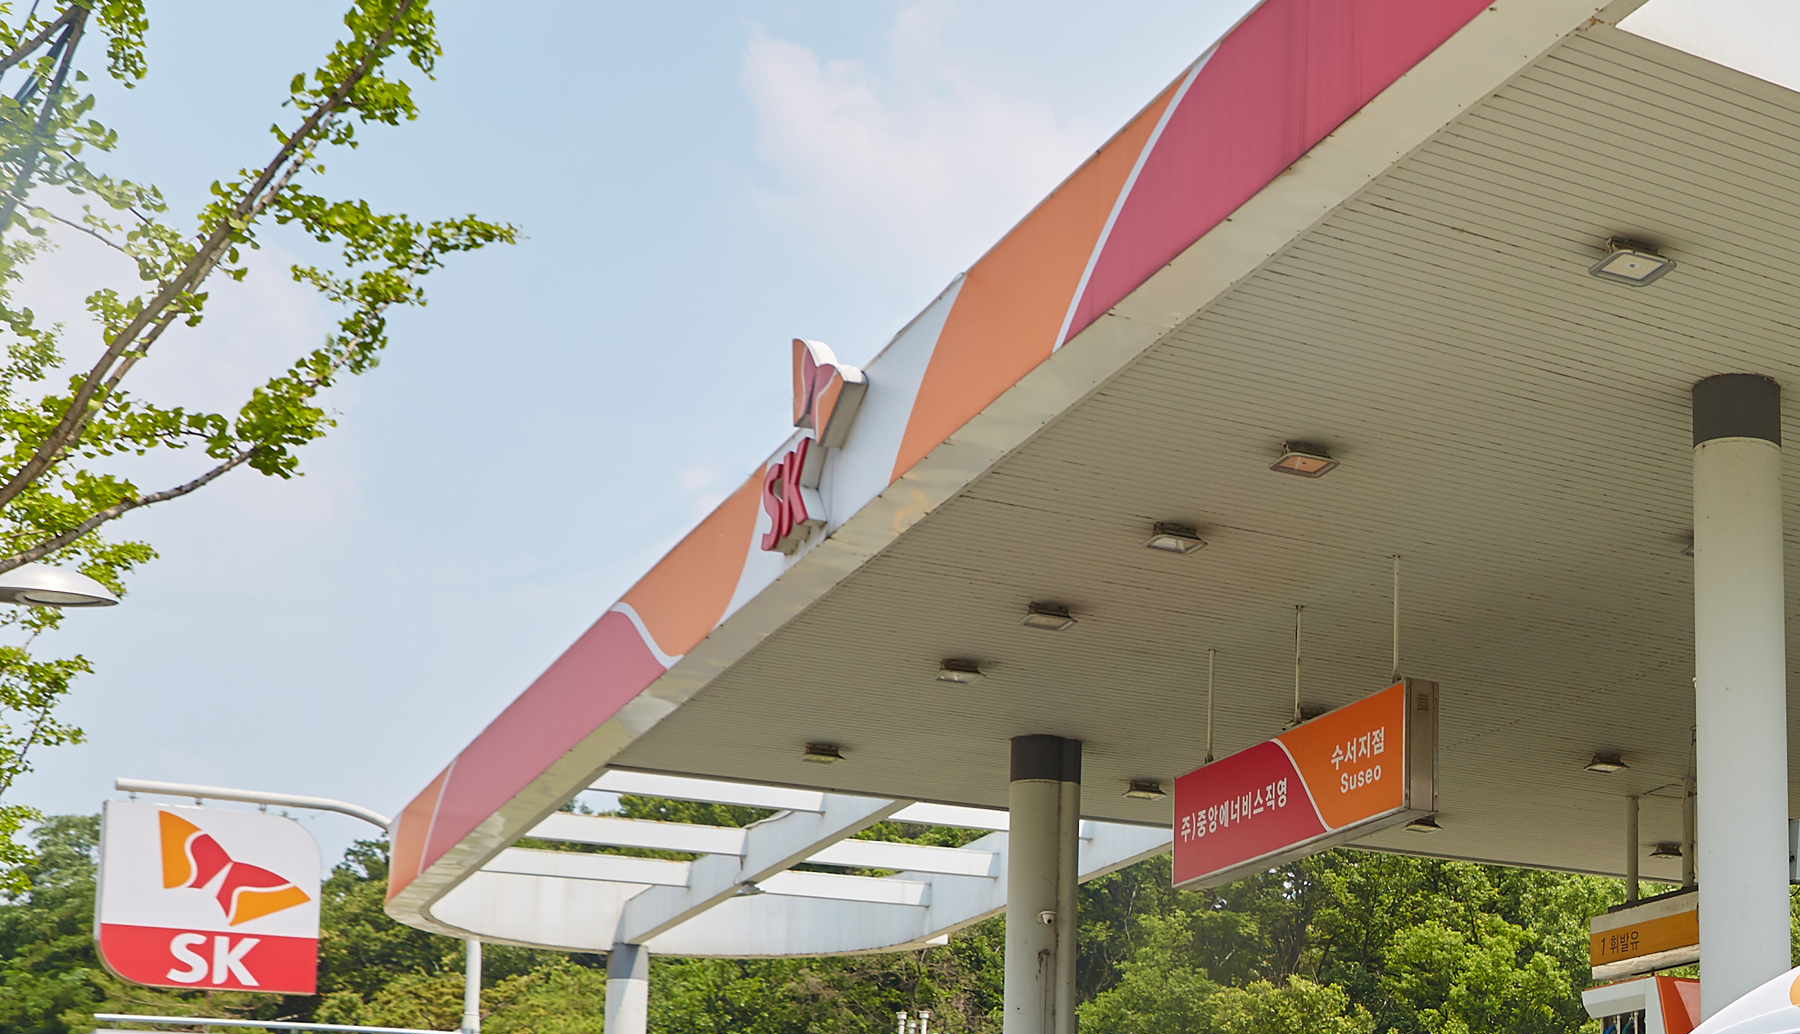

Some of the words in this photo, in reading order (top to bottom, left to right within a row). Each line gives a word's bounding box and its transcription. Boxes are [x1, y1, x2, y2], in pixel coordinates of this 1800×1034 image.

[761, 437, 810, 551] SK
[1331, 727, 1385, 770] 수서지점
[1340, 765, 1382, 794] Suseo
[166, 932, 260, 988] SK
[1601, 938, 1606, 956] 1
[1610, 931, 1640, 954] 휘발유
